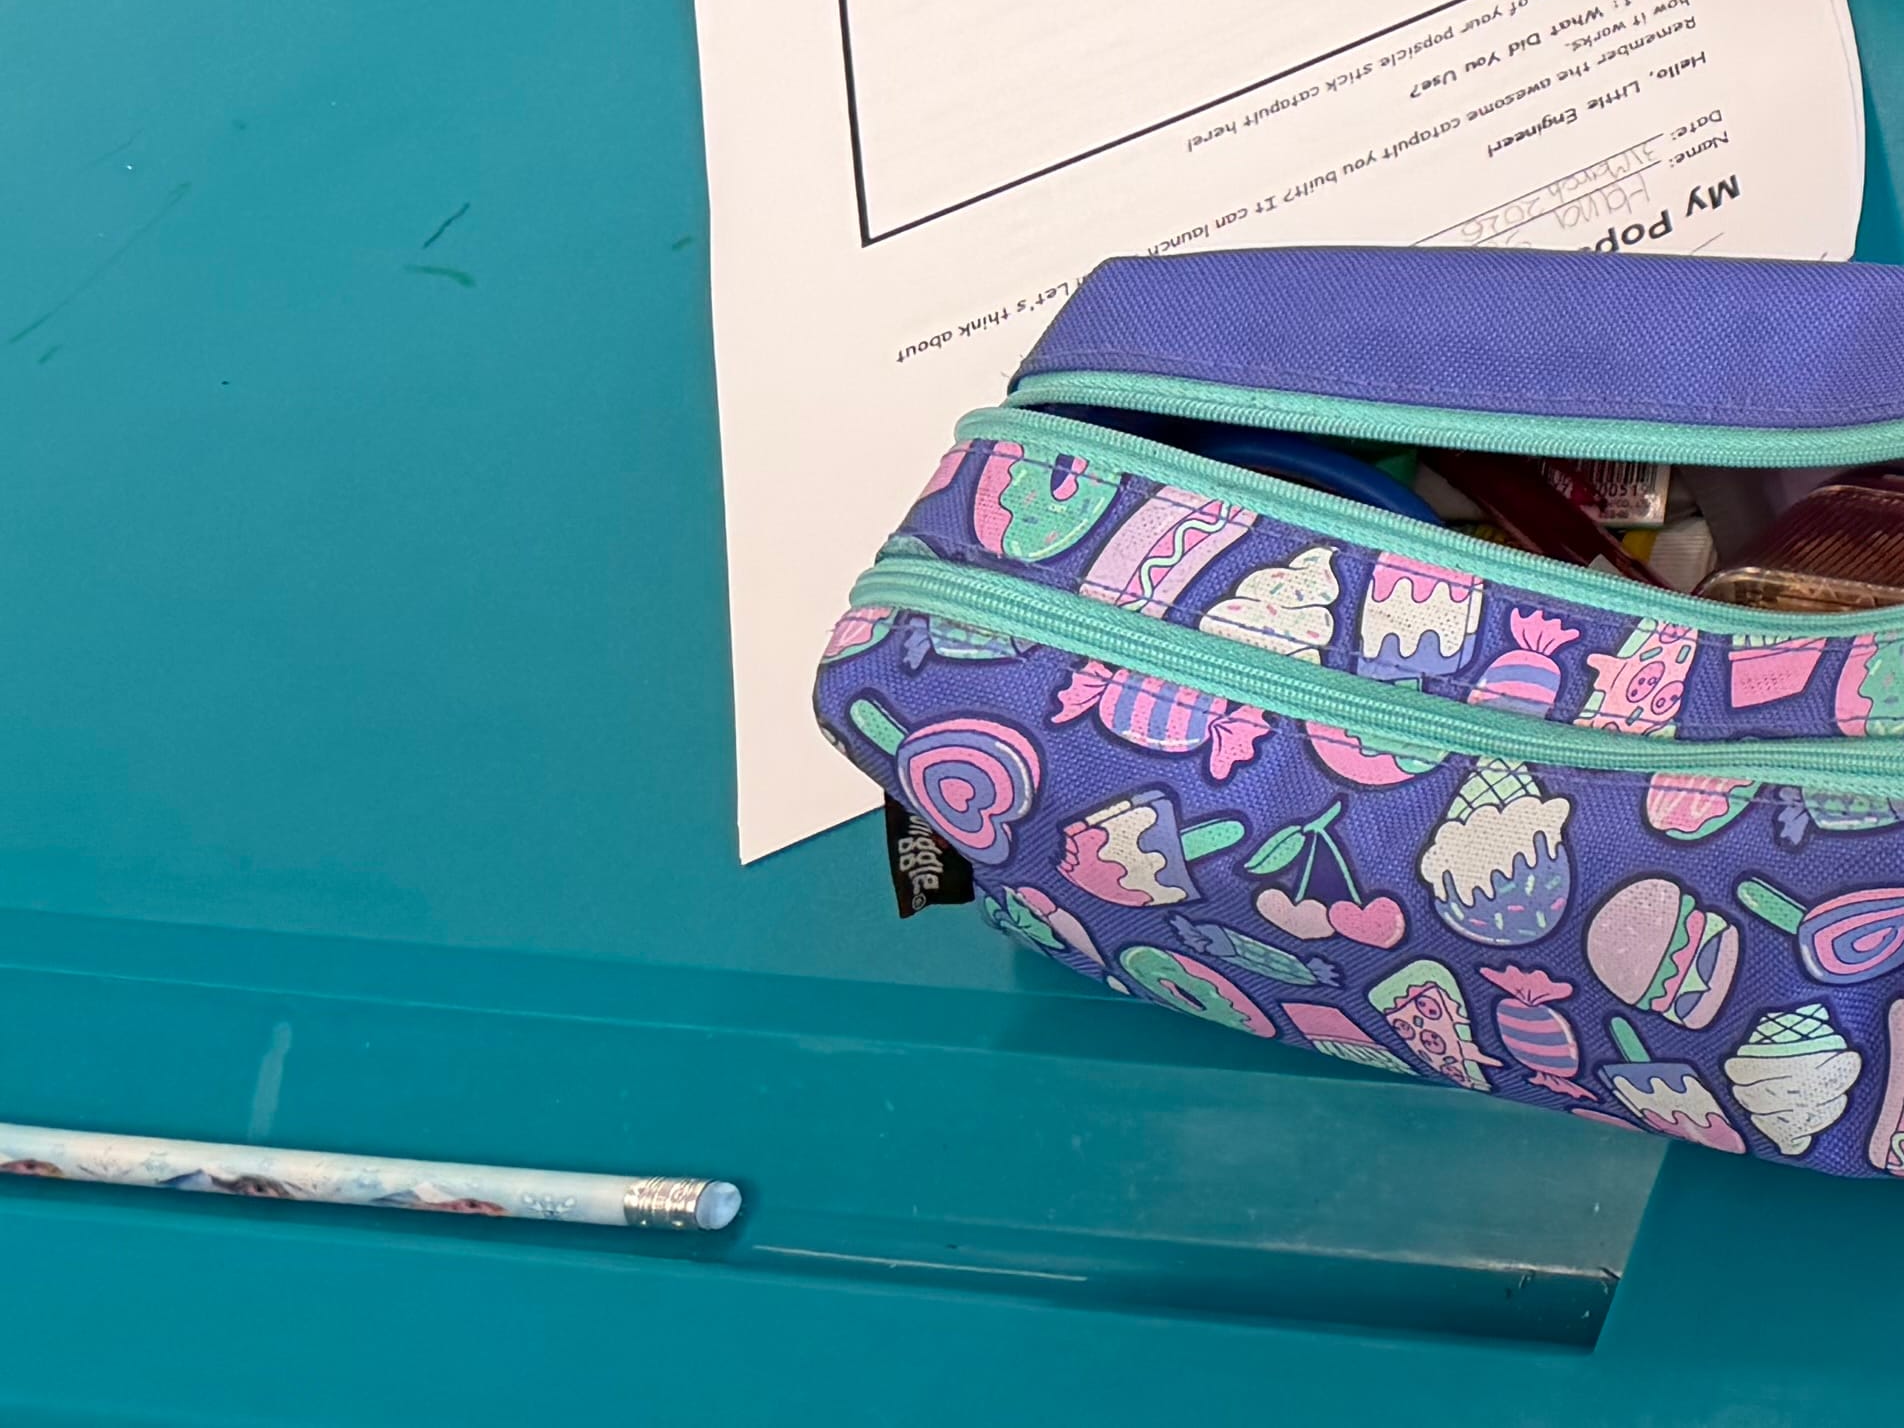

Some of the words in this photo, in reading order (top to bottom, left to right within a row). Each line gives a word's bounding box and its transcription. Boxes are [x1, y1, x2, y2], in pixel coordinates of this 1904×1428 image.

[1460, 5, 1503, 34] your
[1550, 6, 1604, 37] What
[1632, 12, 1647, 26] it
[1379, 25, 1455, 68] popsicle
[1507, 32, 1542, 57] Did
[1564, 21, 1627, 52] works.
[1597, 15, 1697, 65] Remember
[1325, 62, 1373, 92] stick
[1464, 51, 1501, 73] You
[1556, 61, 1590, 82] the
[1649, 50, 1707, 79] Hello,
[1409, 69, 1458, 99] Use?
[1466, 77, 1552, 122] awesome
[1587, 80, 1641, 110] Little
[1243, 86, 1320, 127] catapult
[1187, 121, 1238, 153] here!
[1381, 117, 1461, 160] catapult
[1487, 107, 1578, 158] Engineer!
[1670, 109, 1723, 141] Date:
[1342, 150, 1377, 176] you
[1668, 130, 1729, 168] Name:
[1283, 170, 1338, 203] built?
[1677, 172, 1744, 218] My
[1215, 207, 1249, 229] can
[1255, 195, 1277, 214] It
[1016, 281, 1070, 313] Let's
[957, 307, 1009, 337] think
[898, 330, 953, 363] about
